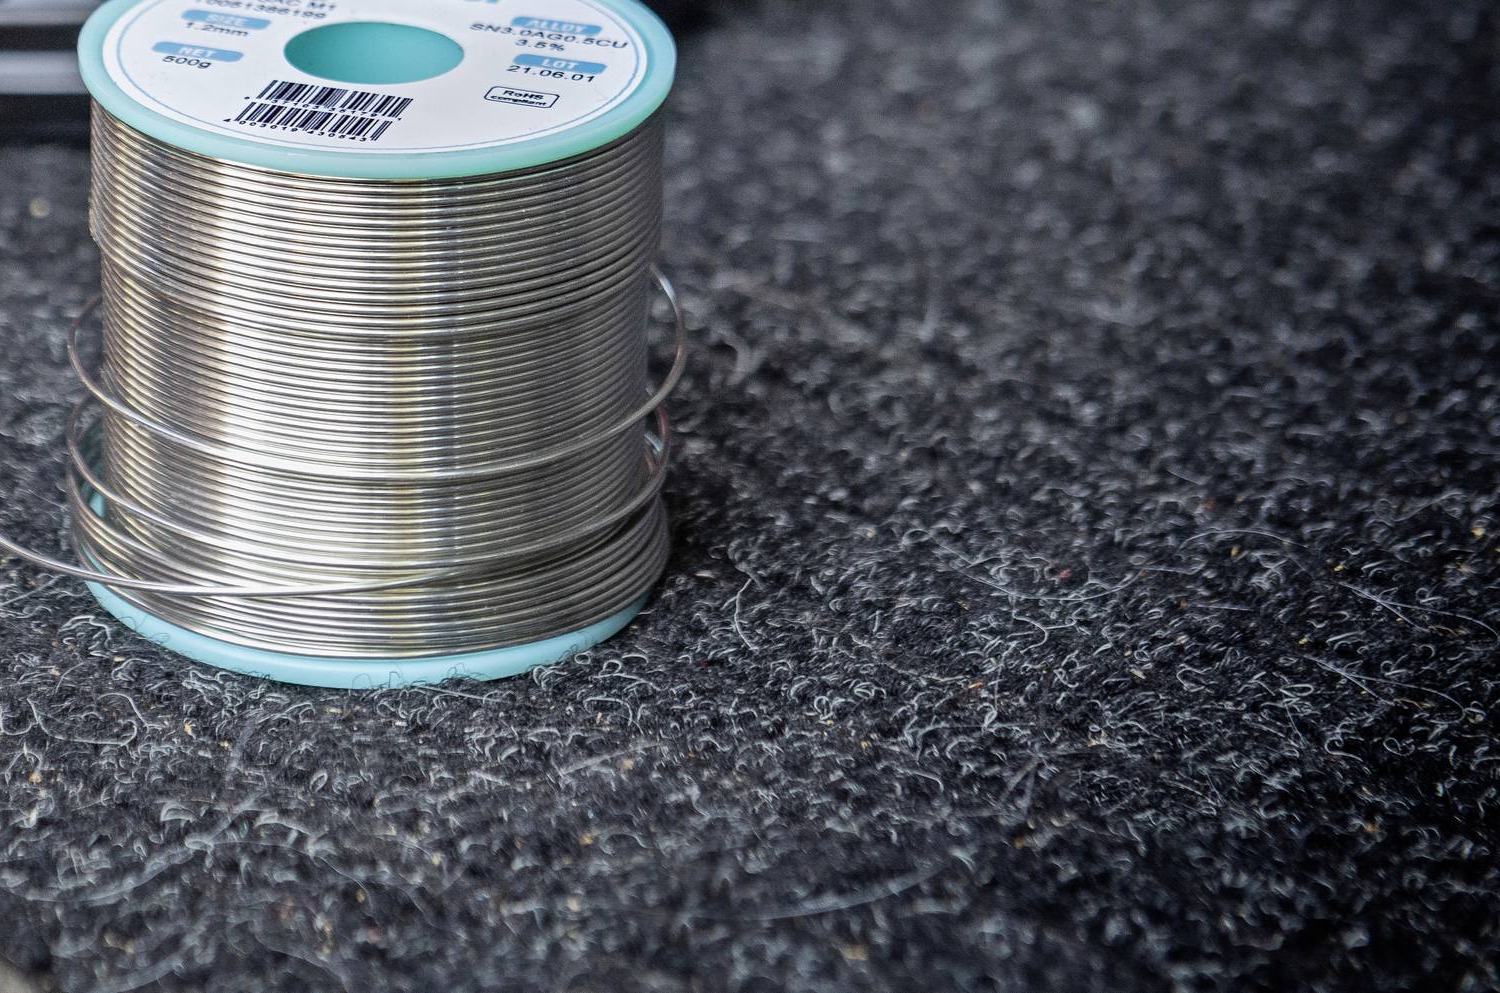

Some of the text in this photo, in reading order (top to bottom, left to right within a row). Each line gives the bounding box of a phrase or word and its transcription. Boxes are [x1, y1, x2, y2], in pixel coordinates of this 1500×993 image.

[185, 21, 249, 37] 1.2mm
[523, 19, 589, 35] ALLOY
[469, 22, 629, 49] SN3.0AG0.5CU
[177, 46, 216, 59] NET
[515, 39, 565, 52] 3.5%
[162, 55, 212, 69] 500g
[540, 58, 581, 71] LOT
[506, 64, 596, 83] 21.06.01
[503, 90, 544, 100] RoHS
